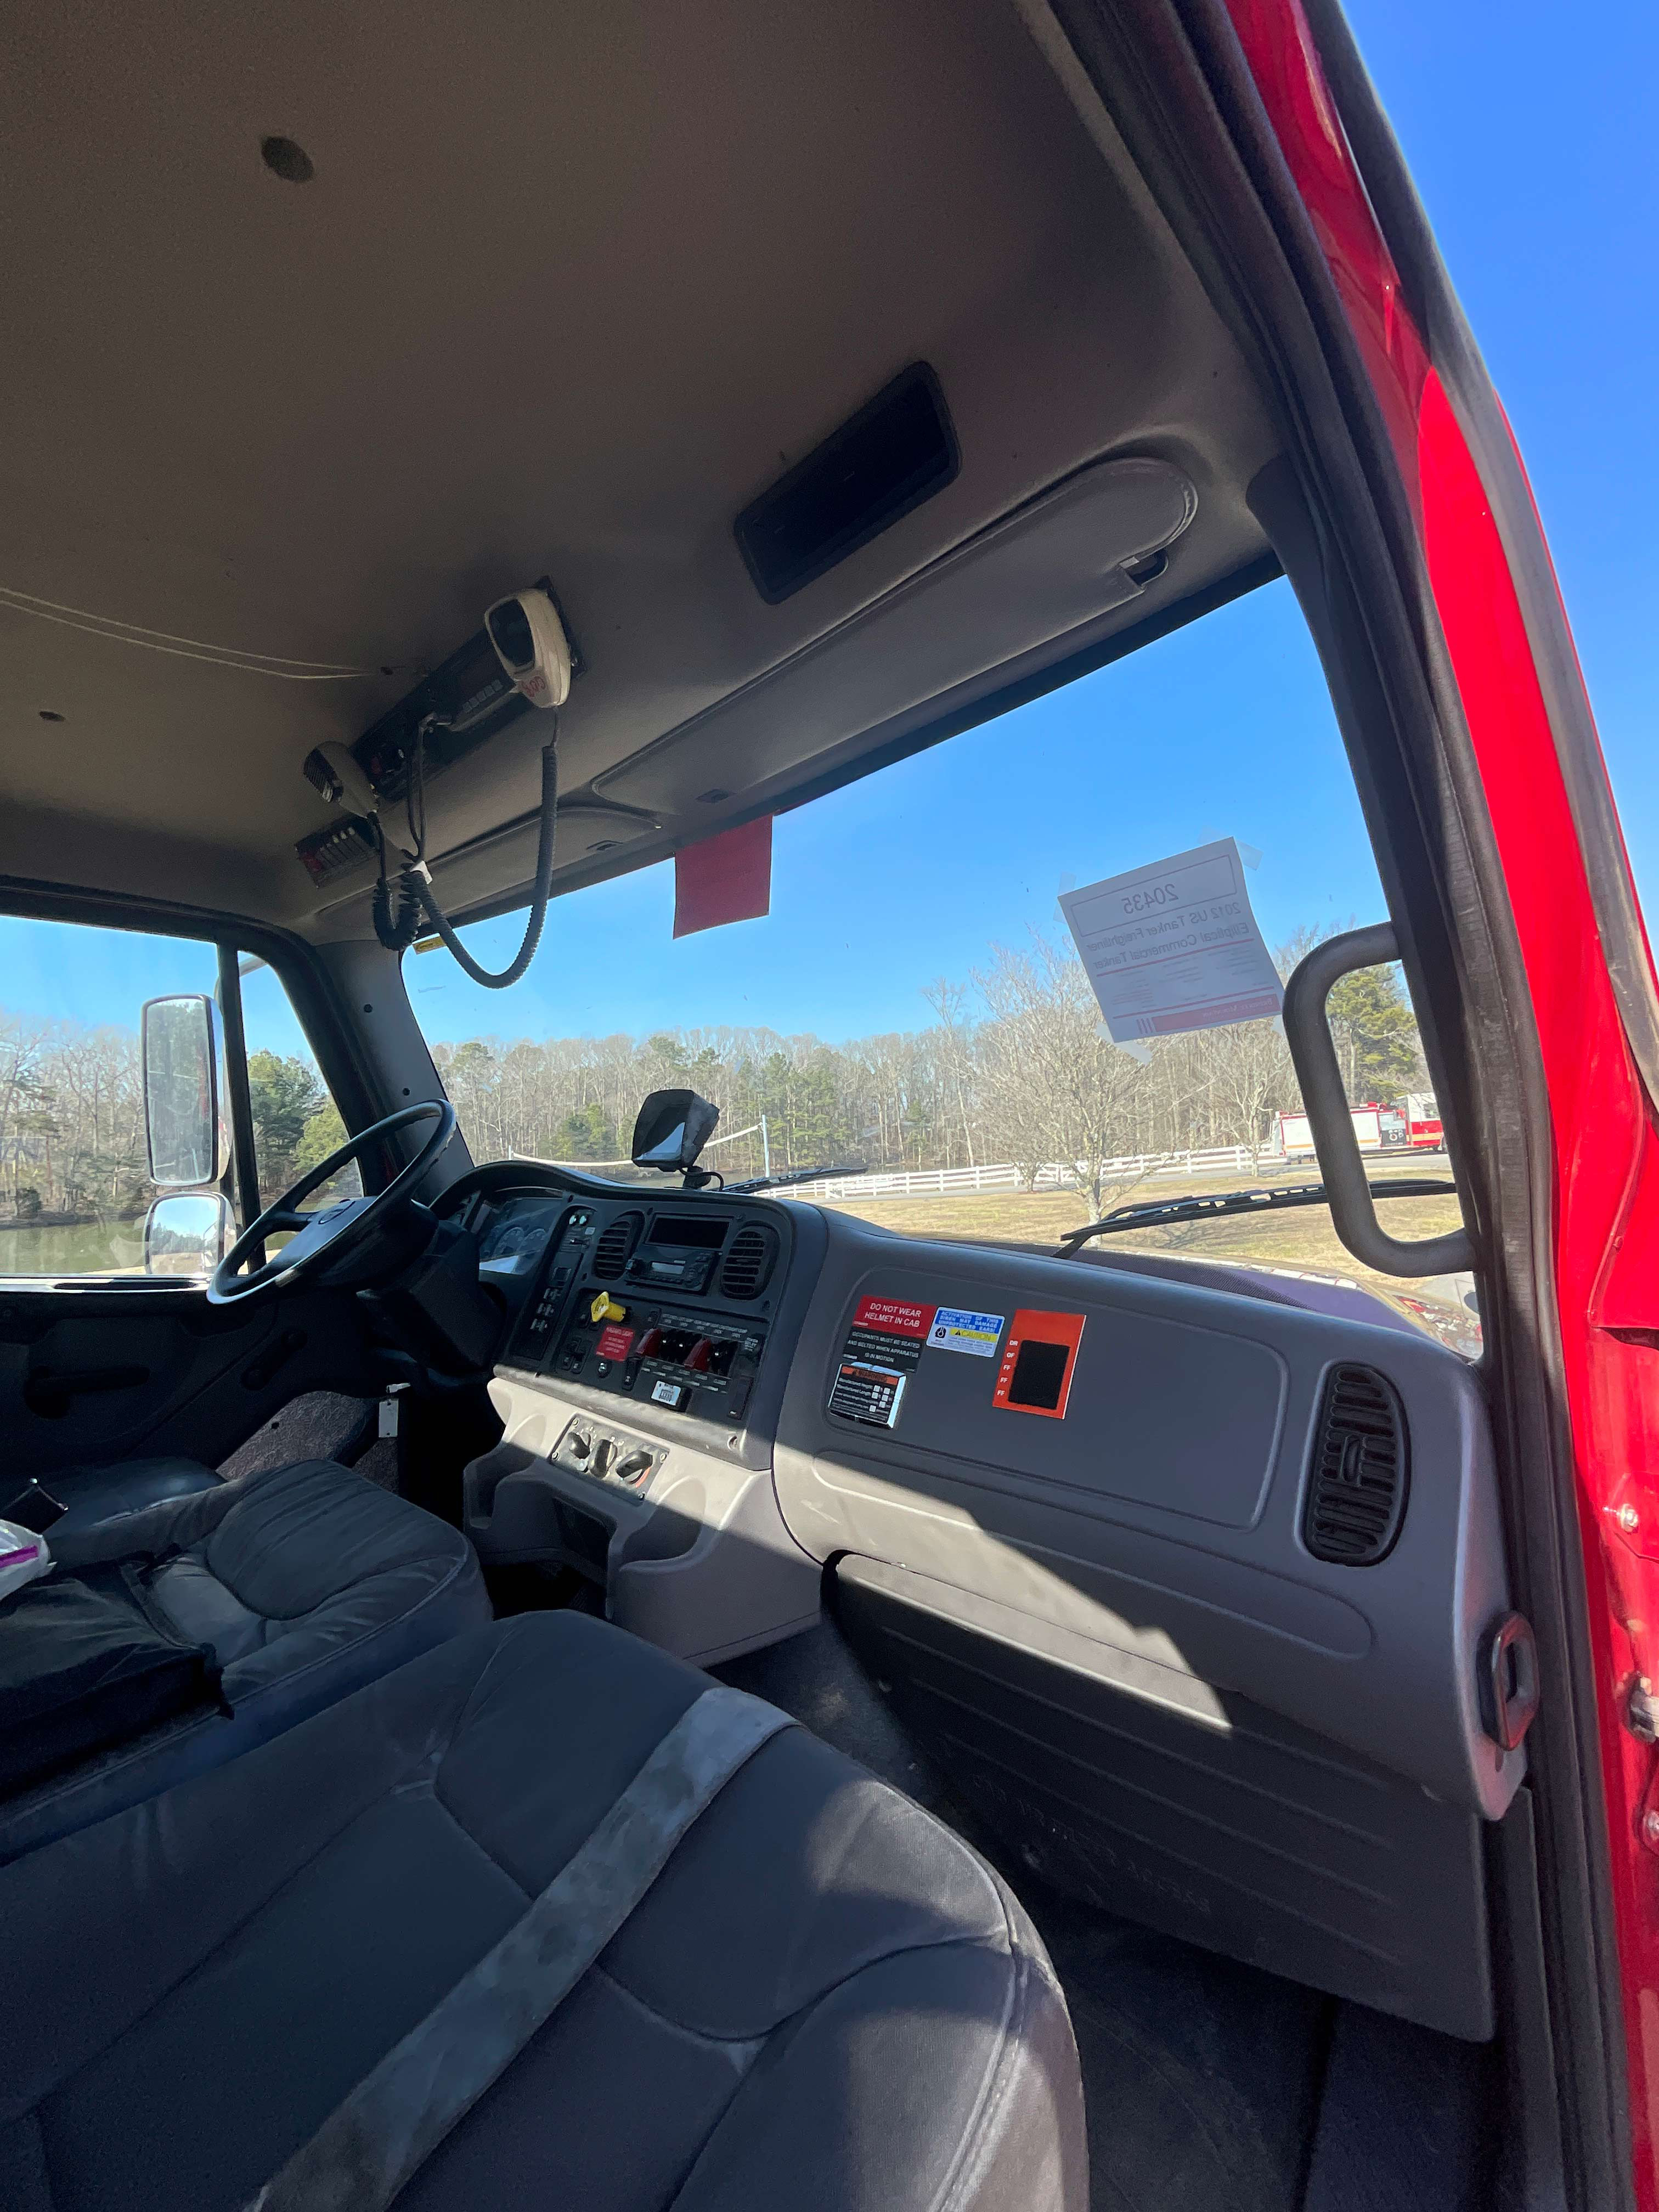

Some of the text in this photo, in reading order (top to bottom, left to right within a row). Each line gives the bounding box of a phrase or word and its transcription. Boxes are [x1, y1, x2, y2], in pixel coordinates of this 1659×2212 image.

[882, 1305, 899, 1313] NOT
[899, 1307, 922, 1317] WEAR
[864, 1312, 894, 1323] HELMET
[904, 1319, 921, 1327] CAB
[852, 1331, 879, 1341] OCCUPANTS
[901, 1340, 920, 1348] SEATED
[961, 1330, 991, 1340] CAUTION
[857, 1341, 876, 1350] BELTED
[890, 1348, 919, 1358] APPARATUS
[876, 1355, 895, 1363] MOTION
